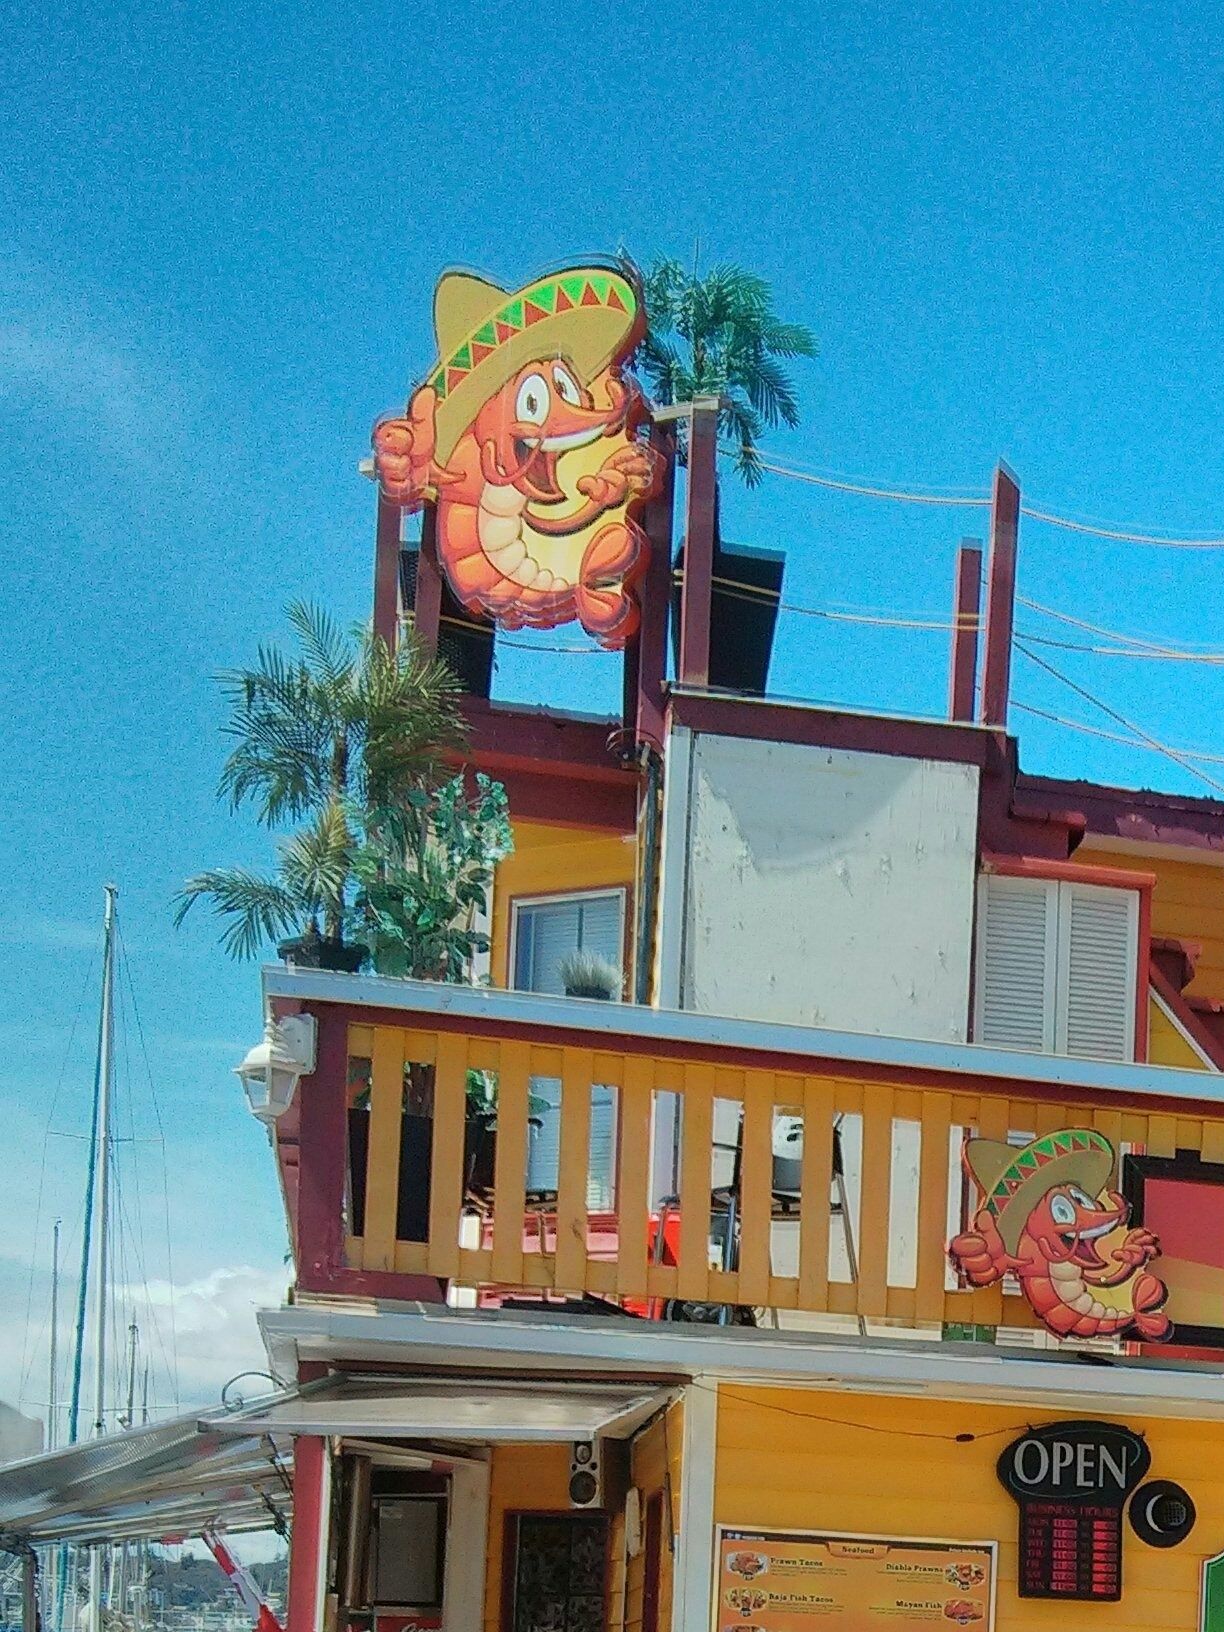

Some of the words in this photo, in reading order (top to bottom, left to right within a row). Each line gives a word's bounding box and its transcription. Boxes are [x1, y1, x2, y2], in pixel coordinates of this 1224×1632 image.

[1014, 1439, 1127, 1489] OPEN
[843, 1546, 874, 1554] Seafood
[771, 1557, 797, 1565] Prawn
